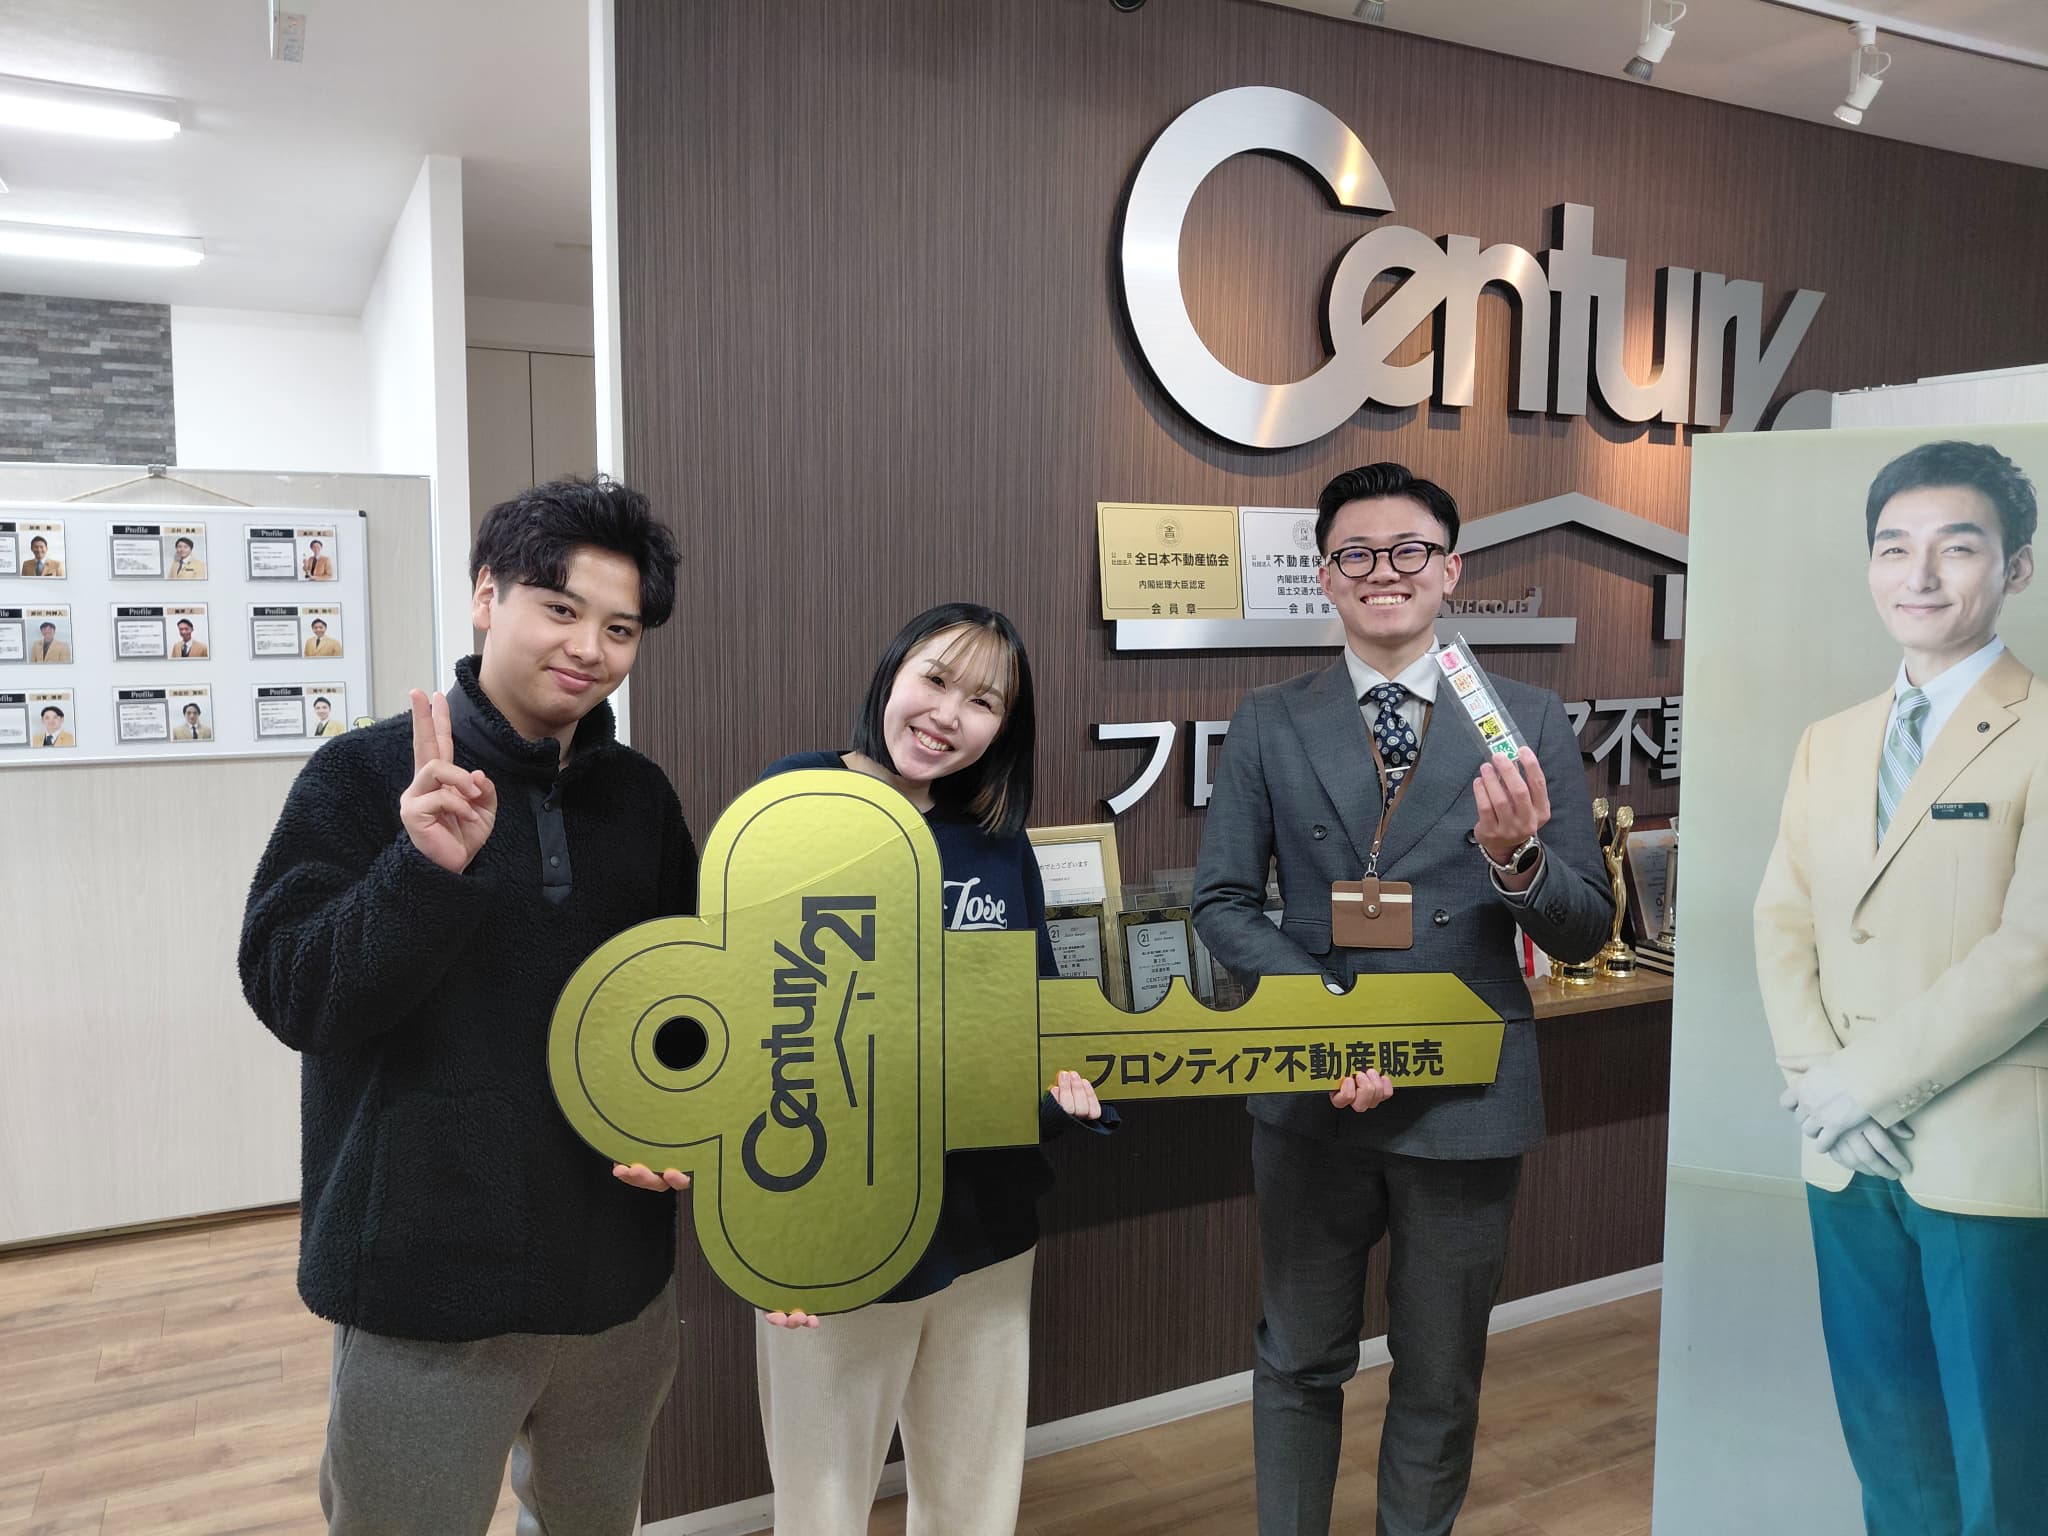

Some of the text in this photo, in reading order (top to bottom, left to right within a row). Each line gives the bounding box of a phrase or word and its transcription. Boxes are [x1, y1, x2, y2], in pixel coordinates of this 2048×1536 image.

[1122, 85, 1825, 447] Century
[125, 526, 148, 534] Profile
[1135, 552, 1229, 567] 全日本不動産協会
[1139, 580, 1206, 590] 内閣総理大臣認定
[129, 608, 152, 616] Profile
[265, 607, 287, 615] Profile
[1151, 603, 1196, 615] 会員章
[1289, 603, 1330, 614] 会員章
[131, 691, 154, 699] Profile
[269, 688, 292, 696] Profile
[741, 939, 827, 1192] Century
[1086, 1039, 1444, 1089] フロンティア不動産販売
